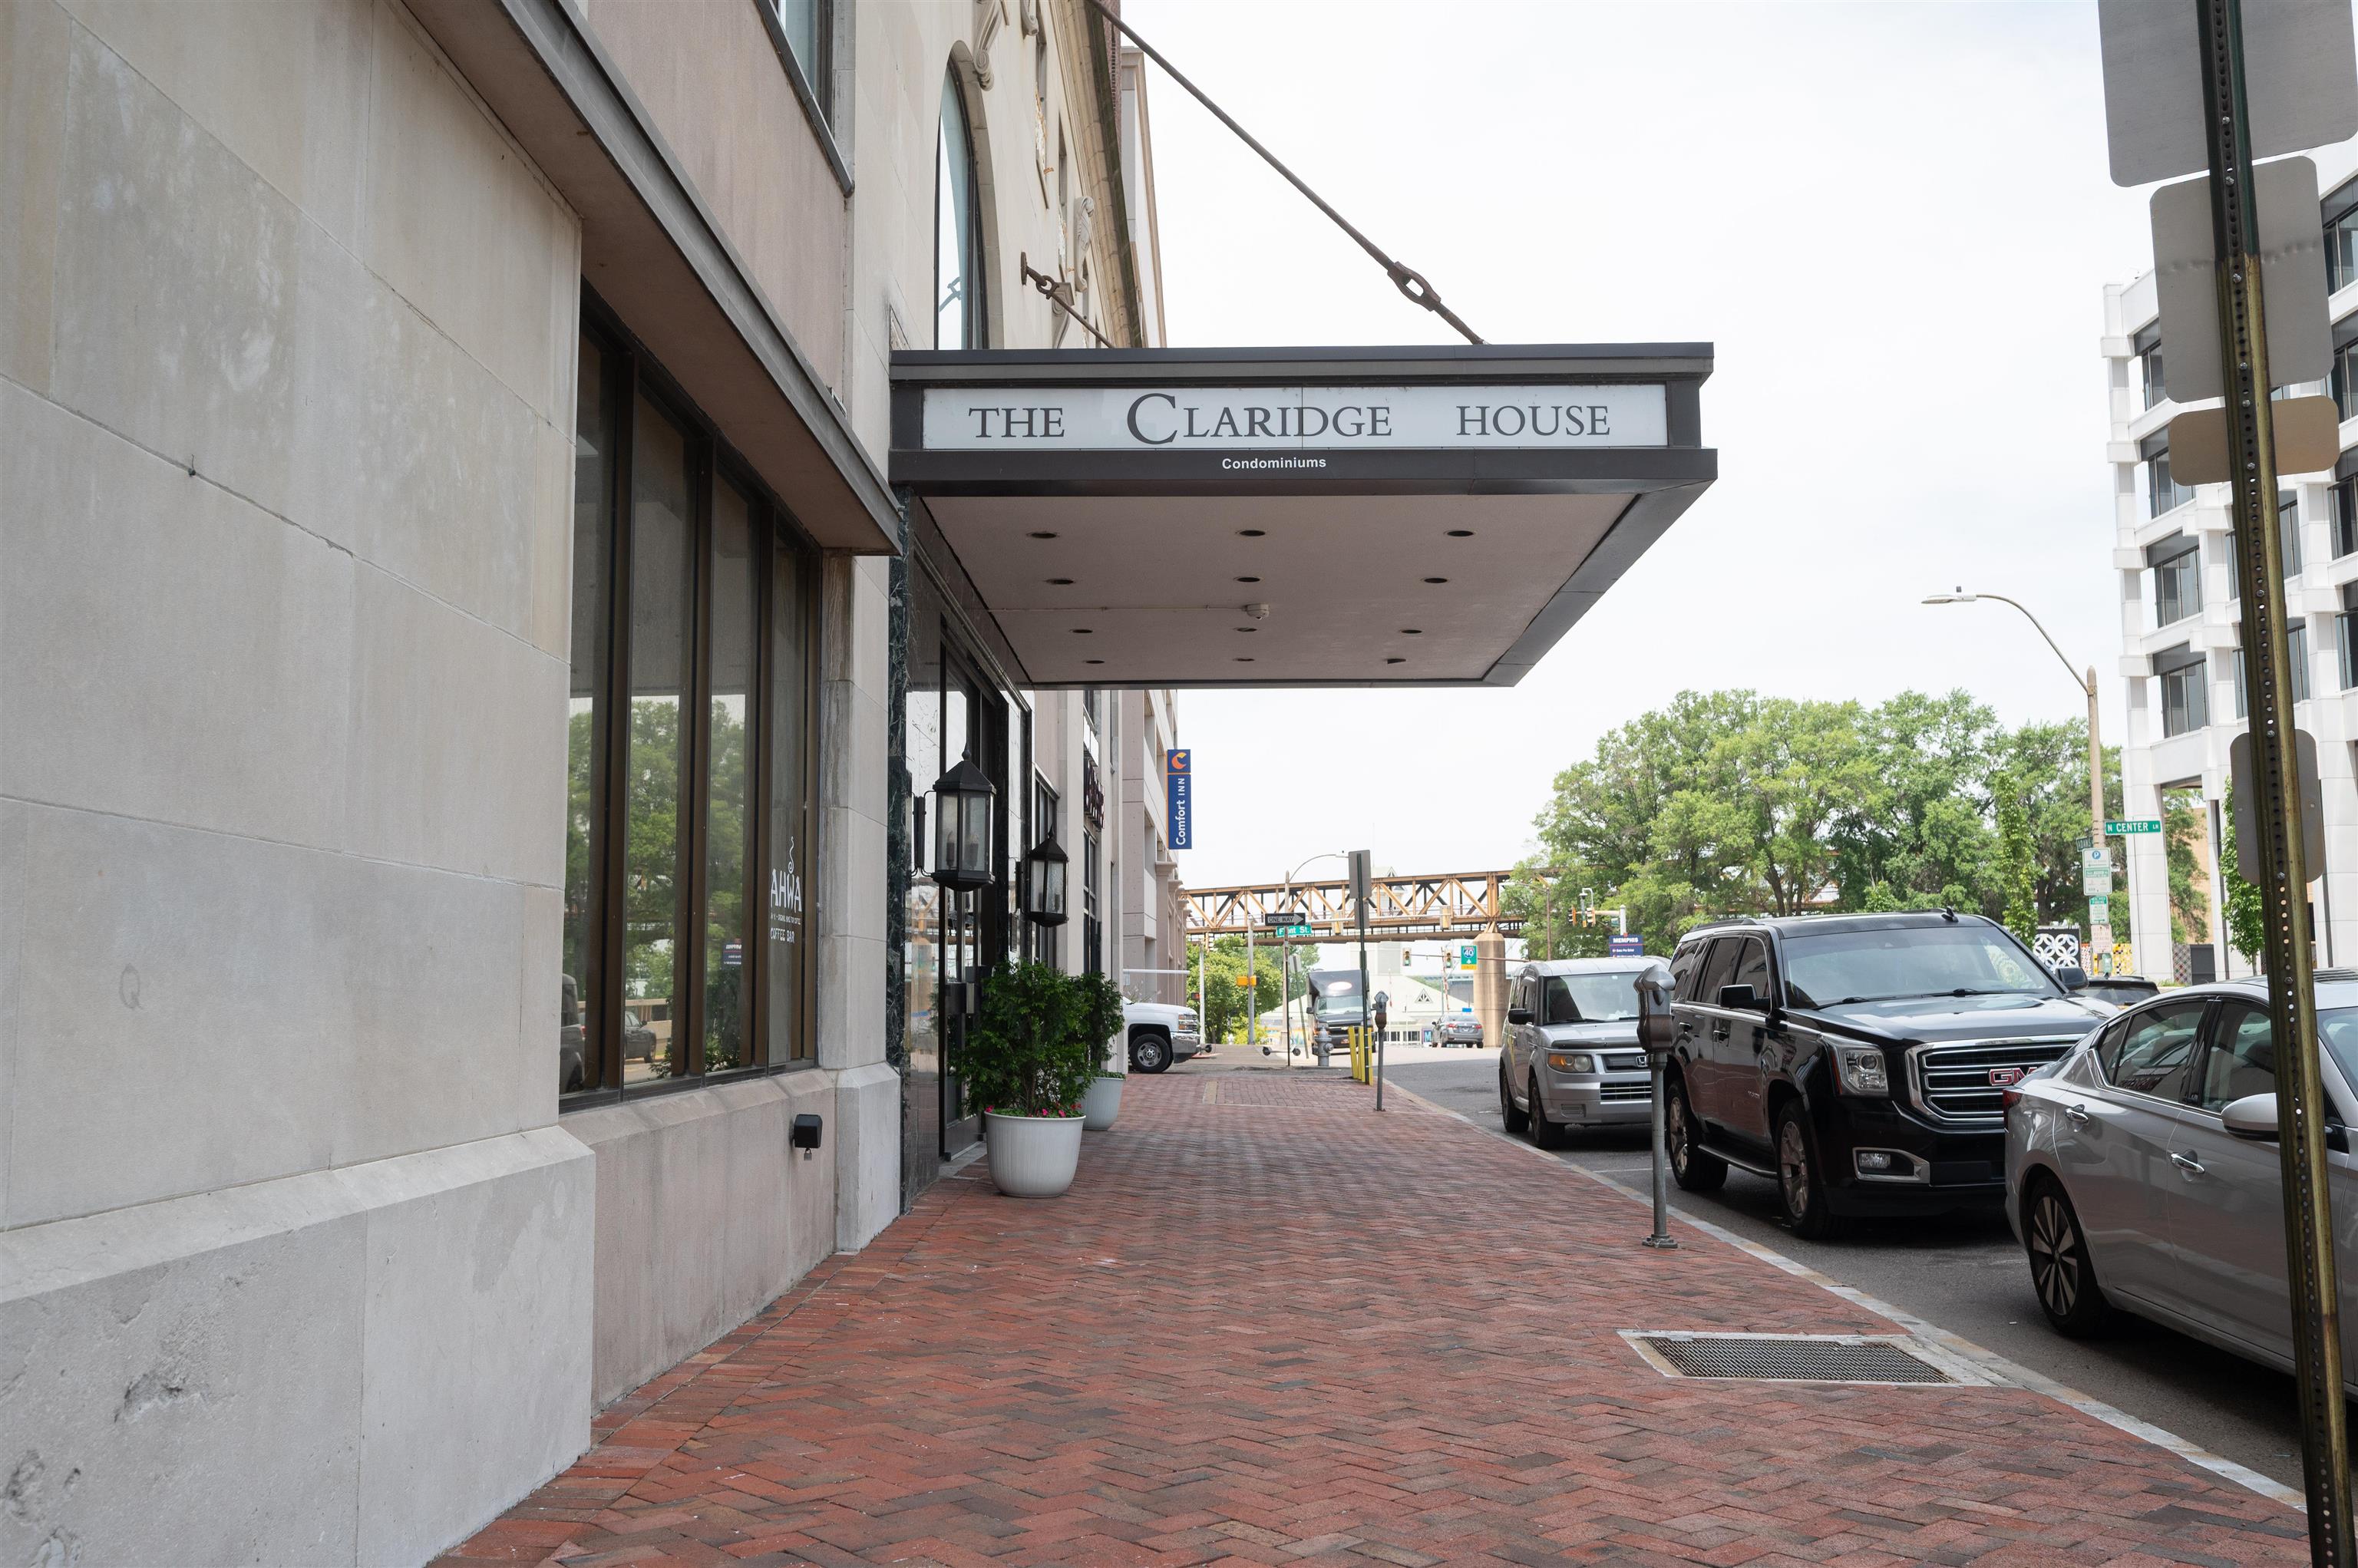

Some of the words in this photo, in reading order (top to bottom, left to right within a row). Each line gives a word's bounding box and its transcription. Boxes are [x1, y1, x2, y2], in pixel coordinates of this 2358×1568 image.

[969, 408, 1065, 437] THE
[1127, 392, 1392, 445] CLARIDGE
[1455, 405, 1610, 436] HOUSE
[1221, 457, 1327, 470] Condominiums
[1175, 800, 1186, 846] Comfort
[2107, 824, 2113, 832] N
[2115, 822, 2148, 833] CENTER
[770, 868, 802, 913] AHWA
[771, 927, 785, 942] COFFEE
[1279, 926, 1296, 935] Fnt
[1300, 926, 1309, 934] St.
[1990, 1067, 2037, 1085] GM
